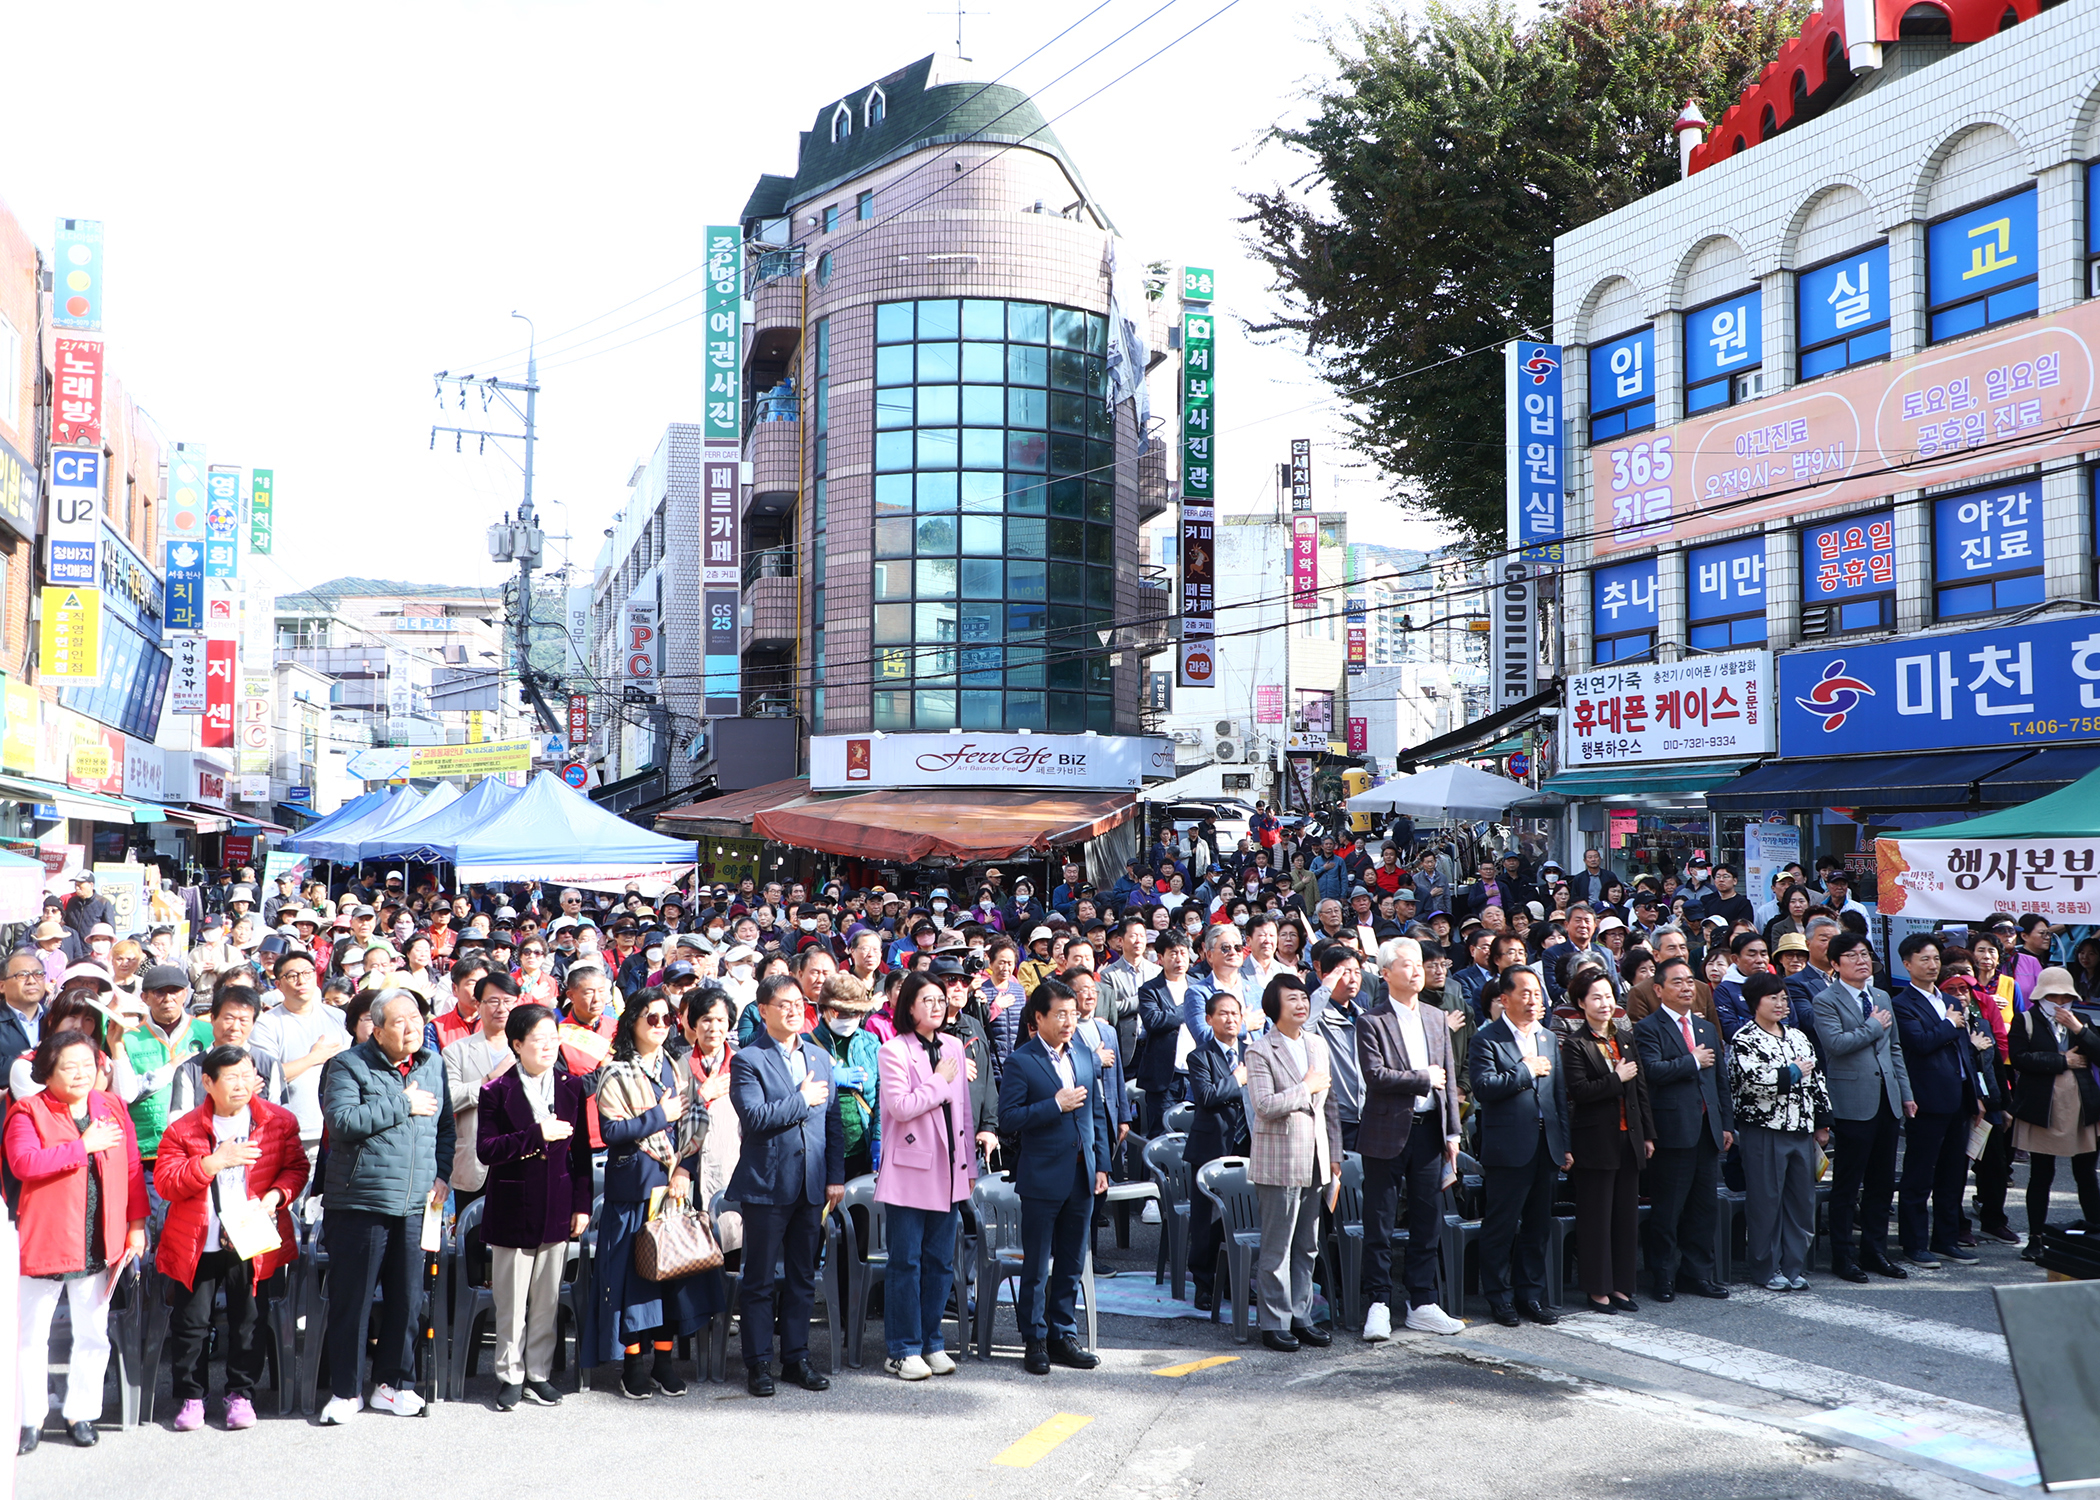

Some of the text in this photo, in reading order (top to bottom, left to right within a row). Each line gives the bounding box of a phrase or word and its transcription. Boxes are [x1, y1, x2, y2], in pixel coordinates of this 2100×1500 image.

[1963, 218, 2018, 280] 교
[1185, 273, 1213, 294] 3층
[1827, 262, 1871, 330] 실
[60, 340, 101, 353] 21세기
[1709, 306, 1748, 367] 원
[1610, 342, 1643, 399] 입
[62, 352, 96, 422] 노래방
[1902, 351, 2060, 422] 토요일, 일요일
[1187, 349, 1210, 489] 서보사진관
[1916, 397, 2043, 458] 공휴일 진료
[1734, 415, 1809, 460] 야간진료
[704, 450, 738, 459] FERR CAFE
[1524, 393, 1556, 535] 입원실
[1611, 435, 1674, 491] 365
[1791, 440, 1845, 482] 밤9시
[56, 458, 95, 481] CF
[255, 477, 271, 489] 서울
[57, 499, 93, 525] U2
[254, 491, 270, 548] 미치과
[710, 467, 733, 562] 페르카페
[1199, 508, 1213, 517] CAFE
[1612, 487, 1674, 544] 진료
[1957, 492, 2032, 532] 야간
[1185, 525, 1212, 540] 커피
[1816, 520, 1892, 561] 일요일
[53, 545, 93, 562] 청바지
[1960, 530, 2033, 571] 진료
[53, 563, 93, 579] 판매점
[214, 569, 229, 577] 3F
[706, 570, 737, 579] 2층 커피
[1298, 540, 1313, 590] 정확당
[1699, 555, 1765, 600] 비만
[1816, 554, 1893, 593] 공휴일
[1185, 583, 1212, 597] 페르
[1601, 575, 1658, 620] 추나
[171, 582, 197, 628] 치과
[711, 603, 732, 616] GS
[1185, 598, 1212, 613] 카페
[205, 621, 236, 629] zishen
[711, 616, 732, 630] 25
[1185, 621, 1212, 630] 2층 커피
[1504, 564, 1527, 698] CODILINE
[54, 611, 71, 674] 호주면세점
[71, 611, 85, 673] 직영할인점
[1188, 660, 1210, 673] 과일
[1653, 659, 1756, 683] 충전기 이어폰 생활잡화
[1895, 640, 2035, 721] 마천
[206, 657, 231, 728] 지센
[1573, 671, 1642, 696] 천연가죽
[1573, 686, 1740, 737] 휴대폰 케이스
[1745, 680, 1758, 725] 전문점
[571, 696, 585, 742] 화장품
[423, 747, 464, 758] 교통통제안내
[1302, 732, 1326, 748] 오꾸꼬
[1581, 739, 1643, 760] 행복하우스
[1663, 735, 1737, 751] 010-7321-9334
[76, 758, 107, 766] 애완용품
[76, 767, 106, 775] 할인매장
[915, 743, 1088, 773] FerrCafe BiZ
[1035, 766, 1087, 776] 페르카비즈
[1127, 778, 1137, 786] 2F
[1761, 837, 1777, 845] 자기장
[1860, 839, 1877, 852] 36
[1994, 900, 2092, 914] (안내, 리플릿, 경품권)
